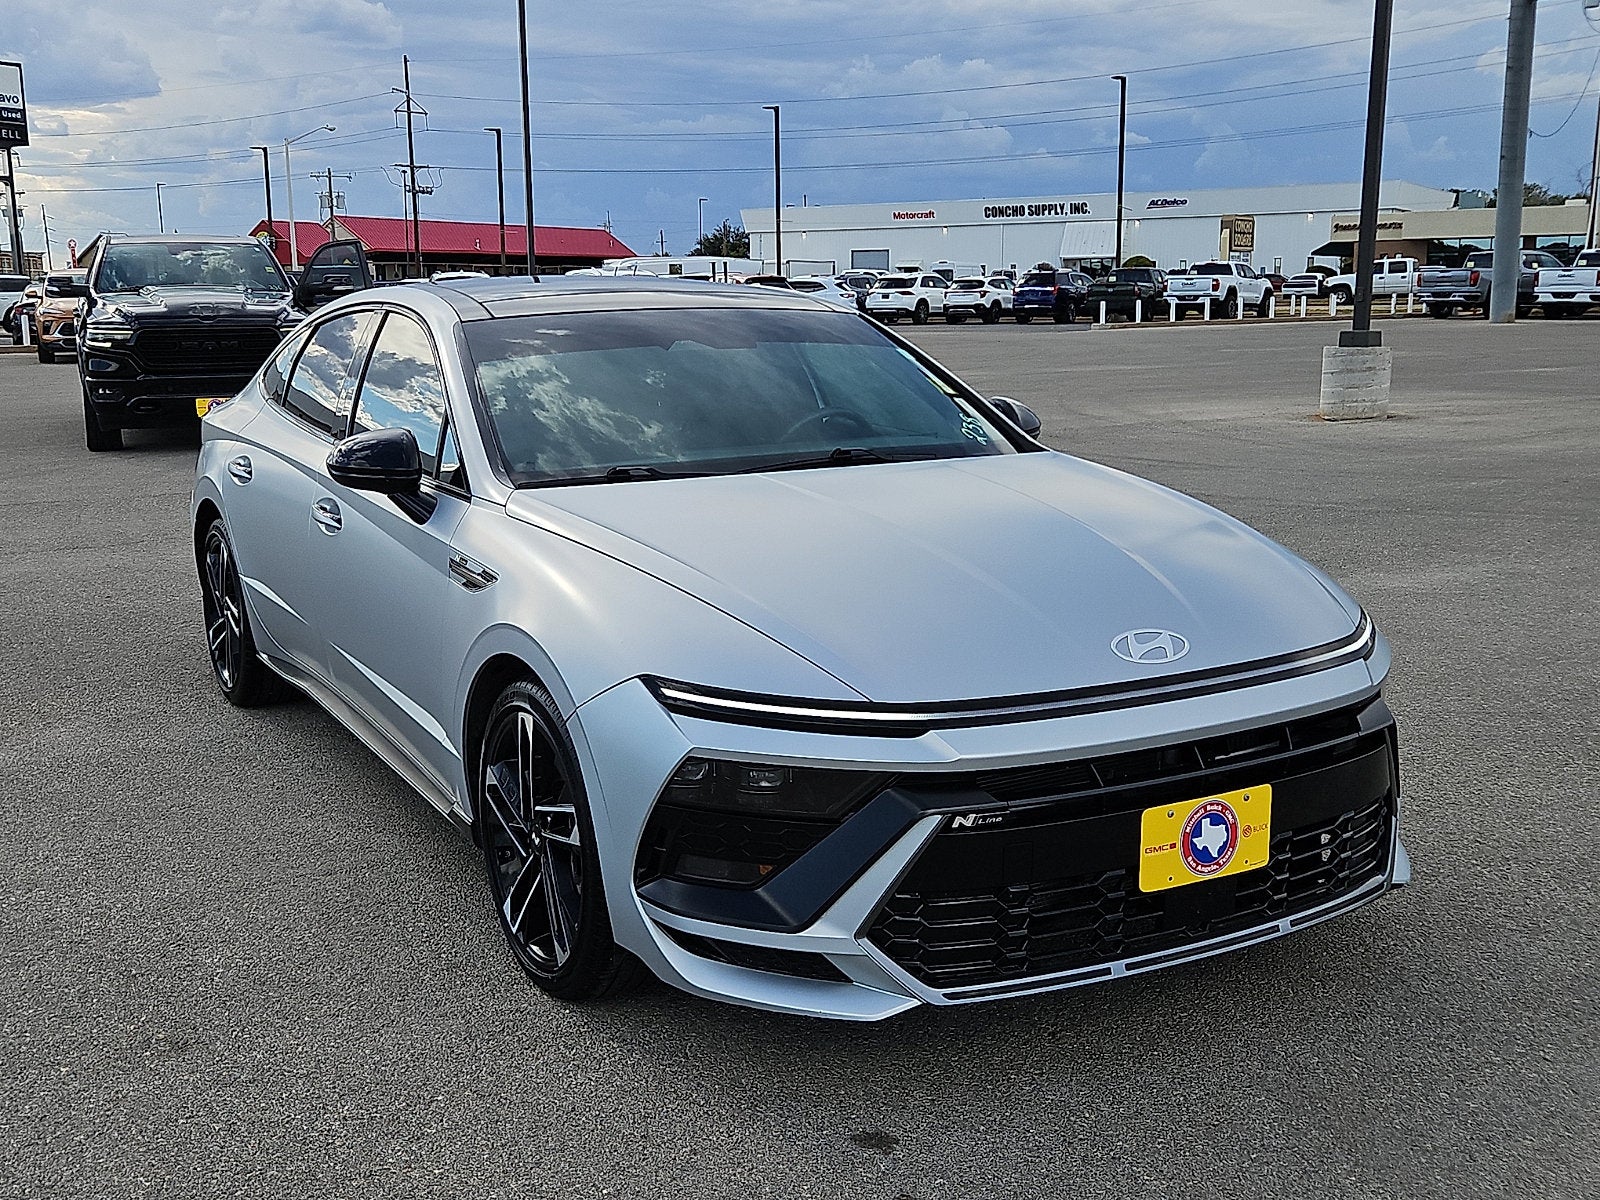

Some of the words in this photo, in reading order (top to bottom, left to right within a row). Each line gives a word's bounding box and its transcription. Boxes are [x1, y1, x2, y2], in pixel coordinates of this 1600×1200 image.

[2, 110, 21, 118] Used
[1147, 198, 1188, 208] ACDelco
[893, 209, 935, 220] Motorcraft
[984, 204, 1025, 219] CONCHO
[1027, 203, 1068, 217] SUPPLY,
[1070, 202, 1091, 215] INC.
[1235, 220, 1253, 233] CONCHO
[952, 814, 977, 828] N
[1253, 823, 1268, 832] BUICK
[1145, 844, 1169, 854] GMC
[1187, 856, 1197, 868] San
